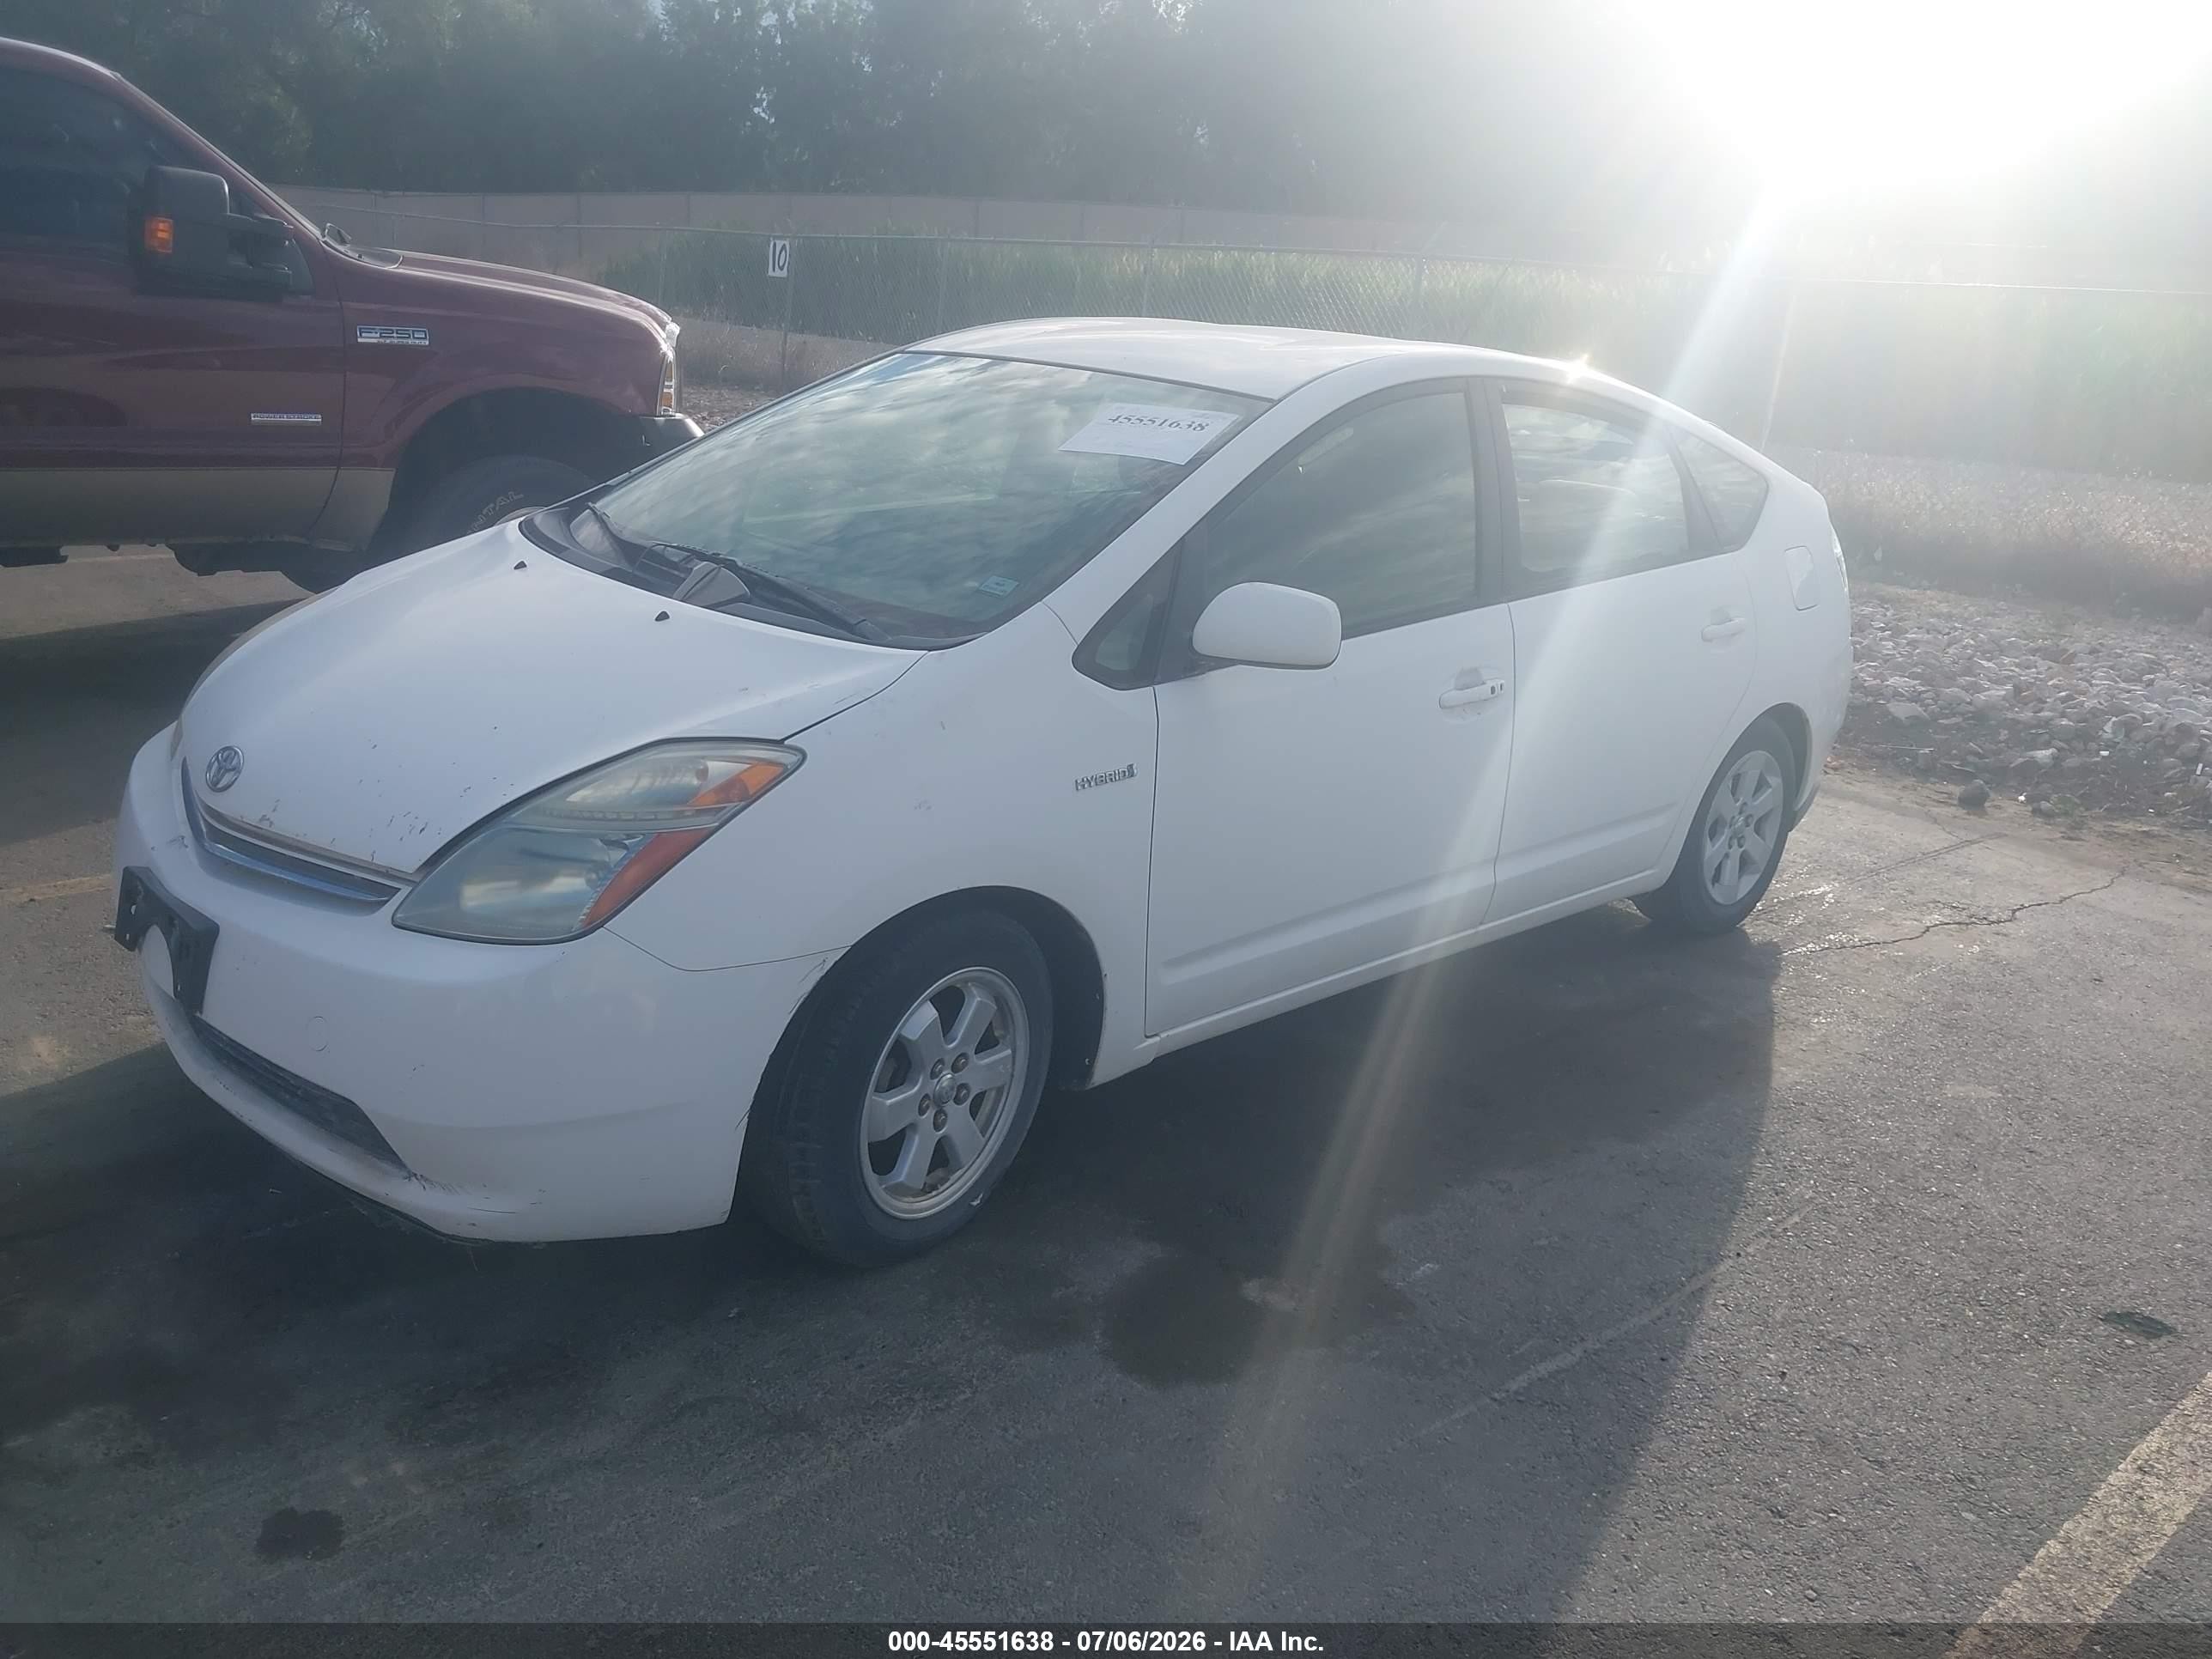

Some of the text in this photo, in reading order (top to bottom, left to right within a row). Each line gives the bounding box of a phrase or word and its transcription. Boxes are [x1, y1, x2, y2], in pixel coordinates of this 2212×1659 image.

[772, 240, 787, 273] 10
[1108, 414, 1209, 432] 45551638
[1074, 768, 1127, 792] HYBRID
